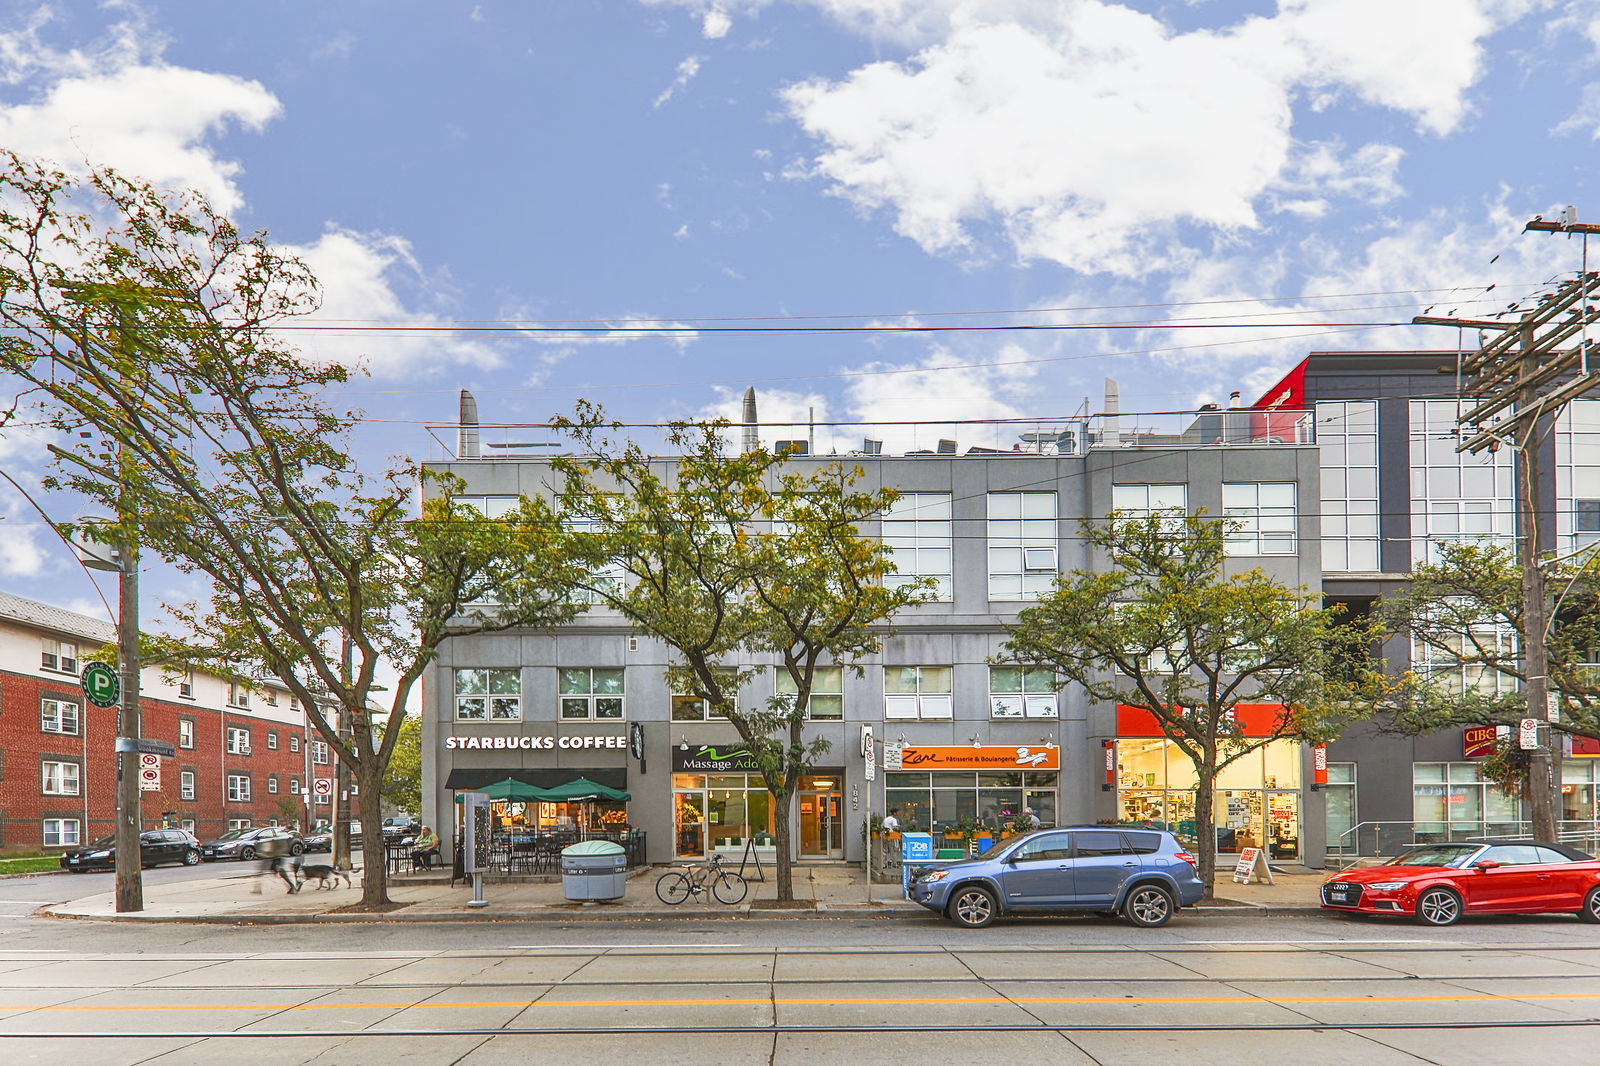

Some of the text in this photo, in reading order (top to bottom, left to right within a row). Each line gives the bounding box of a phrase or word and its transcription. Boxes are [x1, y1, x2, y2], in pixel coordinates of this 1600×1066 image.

[94, 671, 110, 692] P
[1465, 728, 1495, 742] CIBC
[445, 736, 627, 749] STARBUCKS COFFEE
[683, 759, 731, 771] Massage
[981, 756, 1016, 764] Boulangerie
